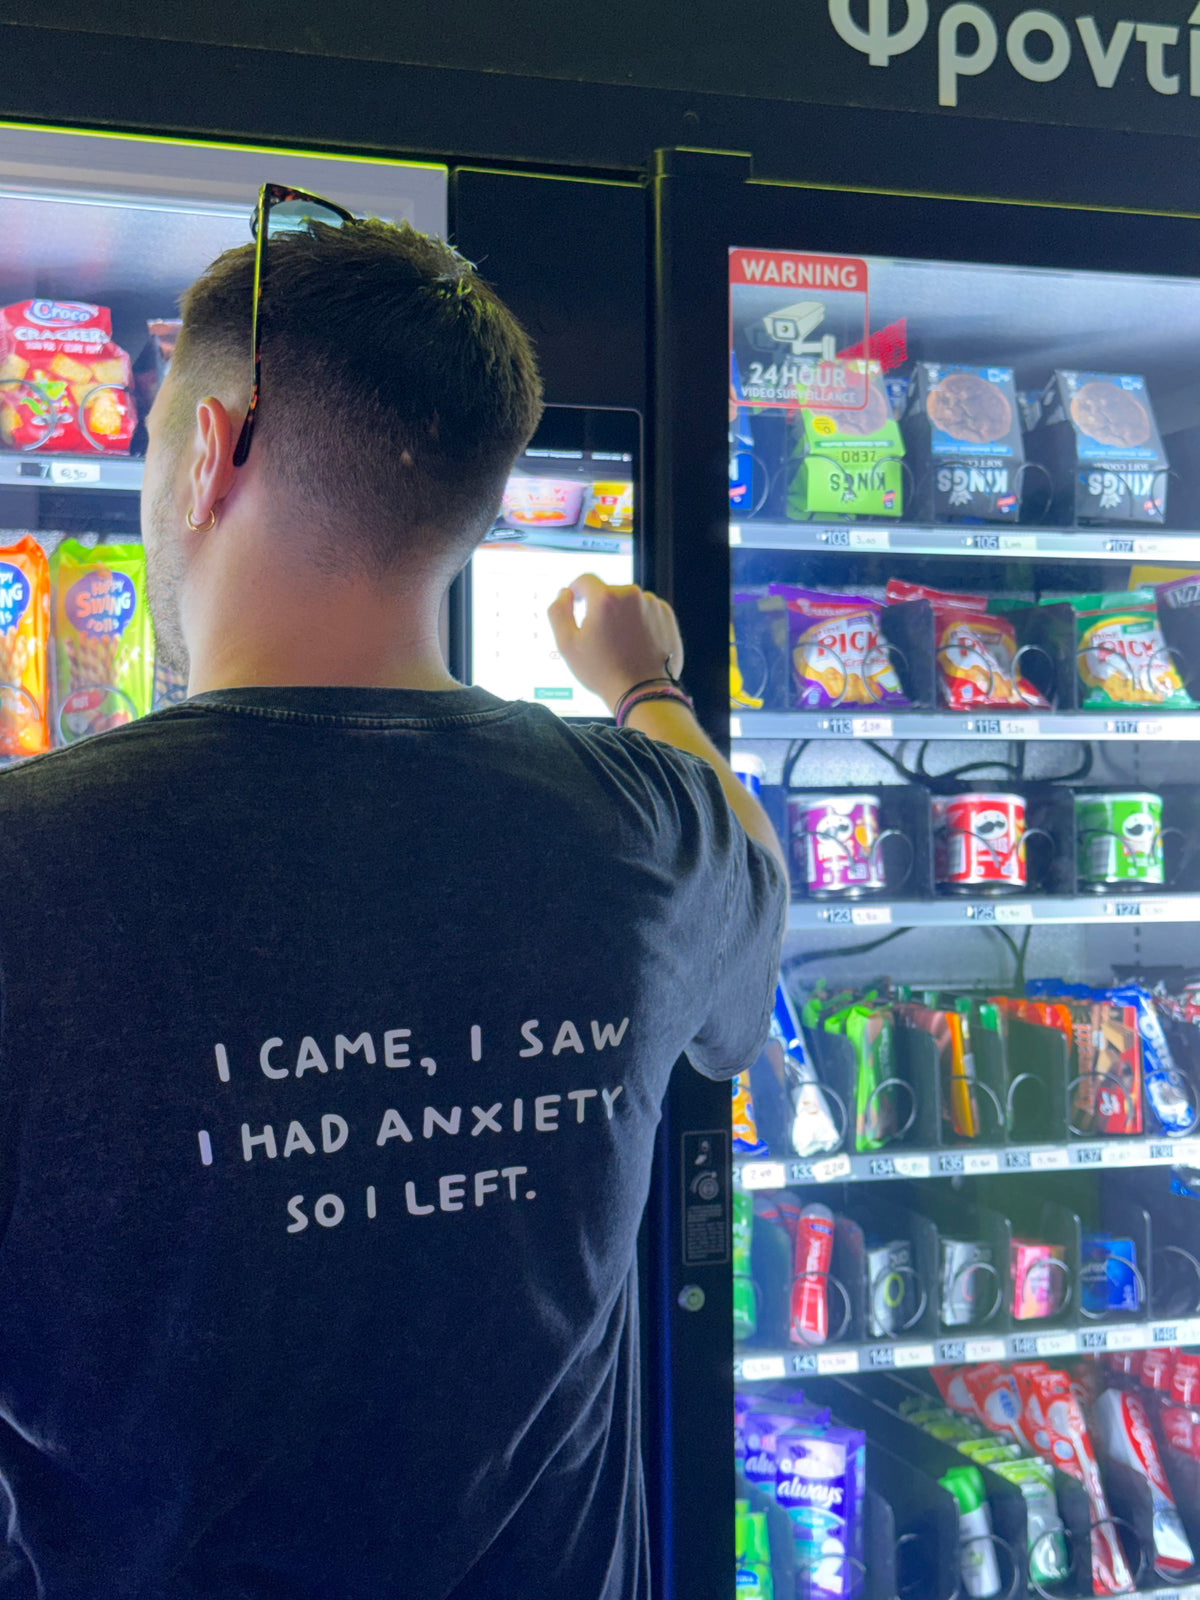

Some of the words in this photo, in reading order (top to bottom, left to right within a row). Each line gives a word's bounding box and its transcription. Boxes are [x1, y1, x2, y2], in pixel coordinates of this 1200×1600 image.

[741, 258, 858, 288] WARNING
[33, 300, 92, 321] Croco
[781, 365, 846, 389] HOUR
[741, 387, 775, 399] VIDEO
[776, 389, 857, 403] SURVEILLANCE
[937, 468, 1009, 493] KINGS
[1088, 471, 1154, 496] KINGS
[826, 531, 849, 545] 103
[975, 536, 997, 549] 105
[1111, 540, 1132, 552] 107
[76, 592, 131, 617] SWING
[817, 630, 884, 657] PICK
[831, 719, 852, 734] 113
[977, 720, 998, 734] 115
[829, 908, 851, 923] 123
[215, 1043, 230, 1082] I
[260, 1028, 437, 1080] CAME,
[471, 1025, 482, 1061] I
[519, 1017, 629, 1058] SAW
[198, 1130, 213, 1165] I
[241, 1114, 348, 1161] HAD
[377, 1086, 623, 1146] ANXIETY
[287, 1194, 345, 1233] SO
[366, 1186, 376, 1219] I
[405, 1166, 536, 1215] LEFT.
[777, 1476, 844, 1508] always
